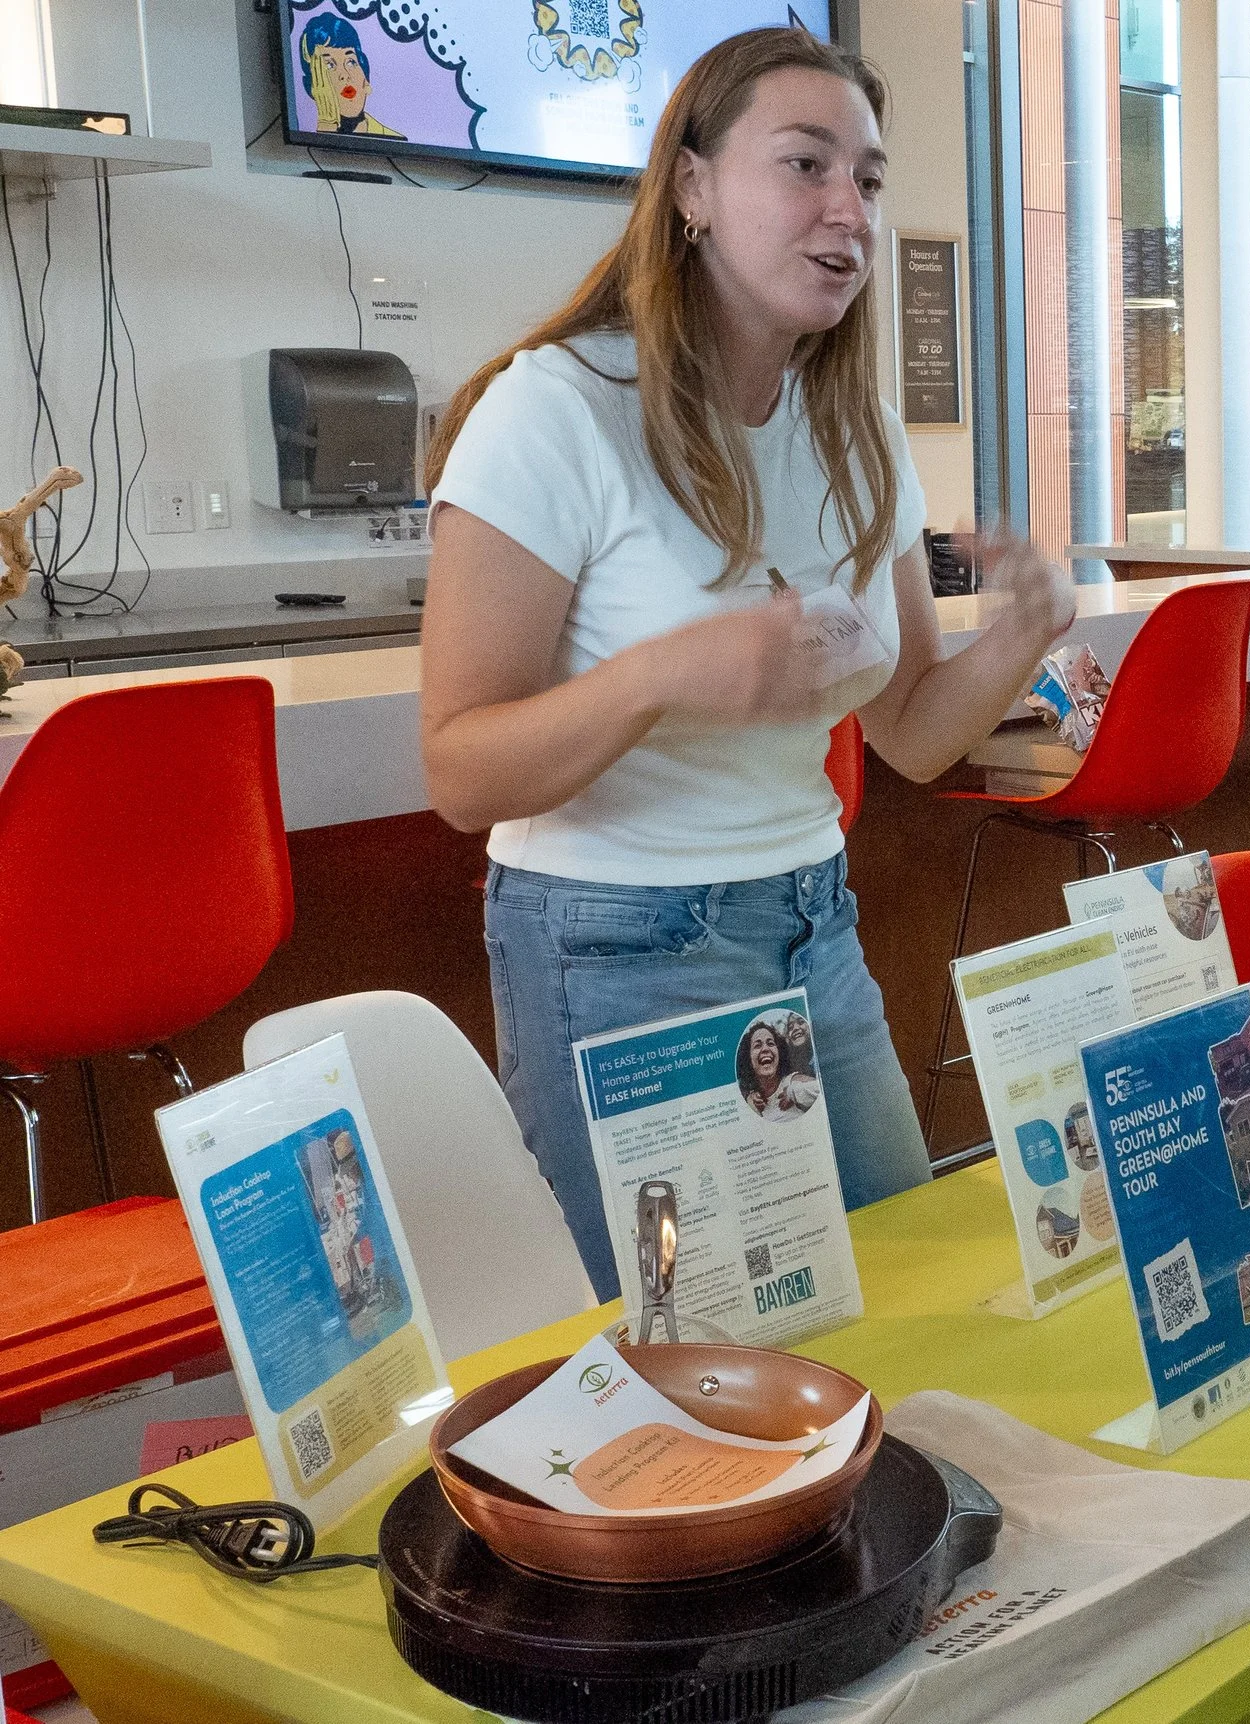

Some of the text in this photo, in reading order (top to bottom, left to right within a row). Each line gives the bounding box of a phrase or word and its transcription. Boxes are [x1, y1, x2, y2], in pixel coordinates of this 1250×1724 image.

[908, 260, 943, 272] Operation
[910, 249, 939, 260] Hours of
[918, 345, 943, 354] TO GO
[1091, 896, 1125, 910] PENINSULA
[1124, 925, 1158, 942] Vehicles
[599, 1034, 719, 1073] It's EASE-y to Upgrade Your
[601, 1049, 725, 1088] Home and Save Money with
[605, 1081, 663, 1105] EASE Home!
[641, 1119, 668, 1130] Efficiency
[685, 1105, 716, 1117] Sustainable
[719, 1099, 737, 1108] Energy
[1109, 1084, 1206, 1136] PENINSULA AND
[1114, 1115, 1180, 1158] SOUTH BAY
[1119, 1126, 1209, 1178] GREEN@HOME
[210, 1170, 271, 1208] Induction Cooktop
[621, 1179, 638, 1188] What
[638, 1175, 648, 1184] Are
[647, 1172, 658, 1181] the
[1122, 1171, 1159, 1200] TOUR
[215, 1189, 264, 1220] Loan Program
[754, 1266, 817, 1315] BAYREN
[593, 1376, 629, 1408] Acterra
[592, 1453, 630, 1481] Induction
[602, 1468, 639, 1492] Lending
[633, 1446, 668, 1470] Program
[921, 1589, 998, 1638] cterra
[926, 1589, 1041, 1655] ACTION FOR A
[944, 1587, 1068, 1659] HEALTHY PLANET
